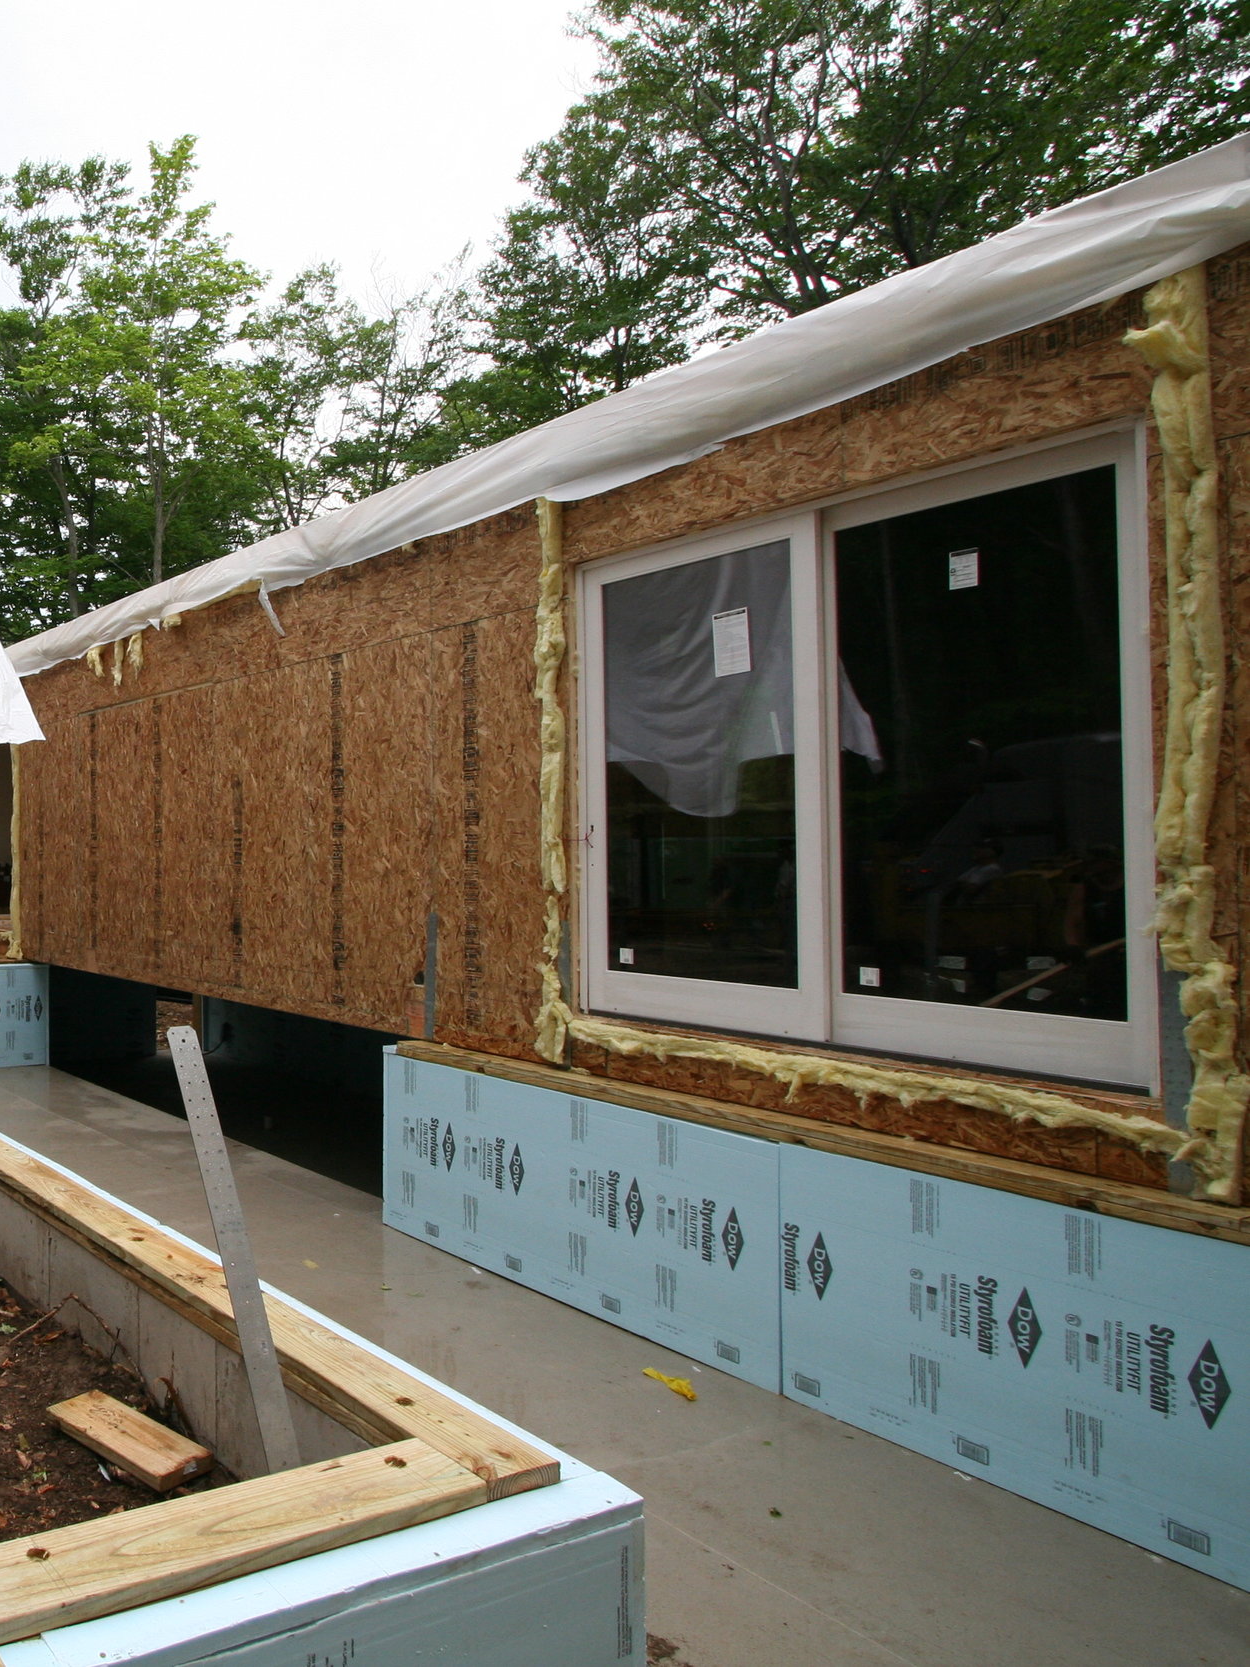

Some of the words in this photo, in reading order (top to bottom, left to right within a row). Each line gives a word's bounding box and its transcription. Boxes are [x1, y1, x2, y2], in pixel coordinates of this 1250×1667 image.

[630, 1191, 639, 1226] DOW
[727, 1221, 738, 1259] DOW
[814, 1247, 826, 1289] DOW
[1017, 1305, 1033, 1353] DOW
[1199, 1359, 1219, 1415] DOW
